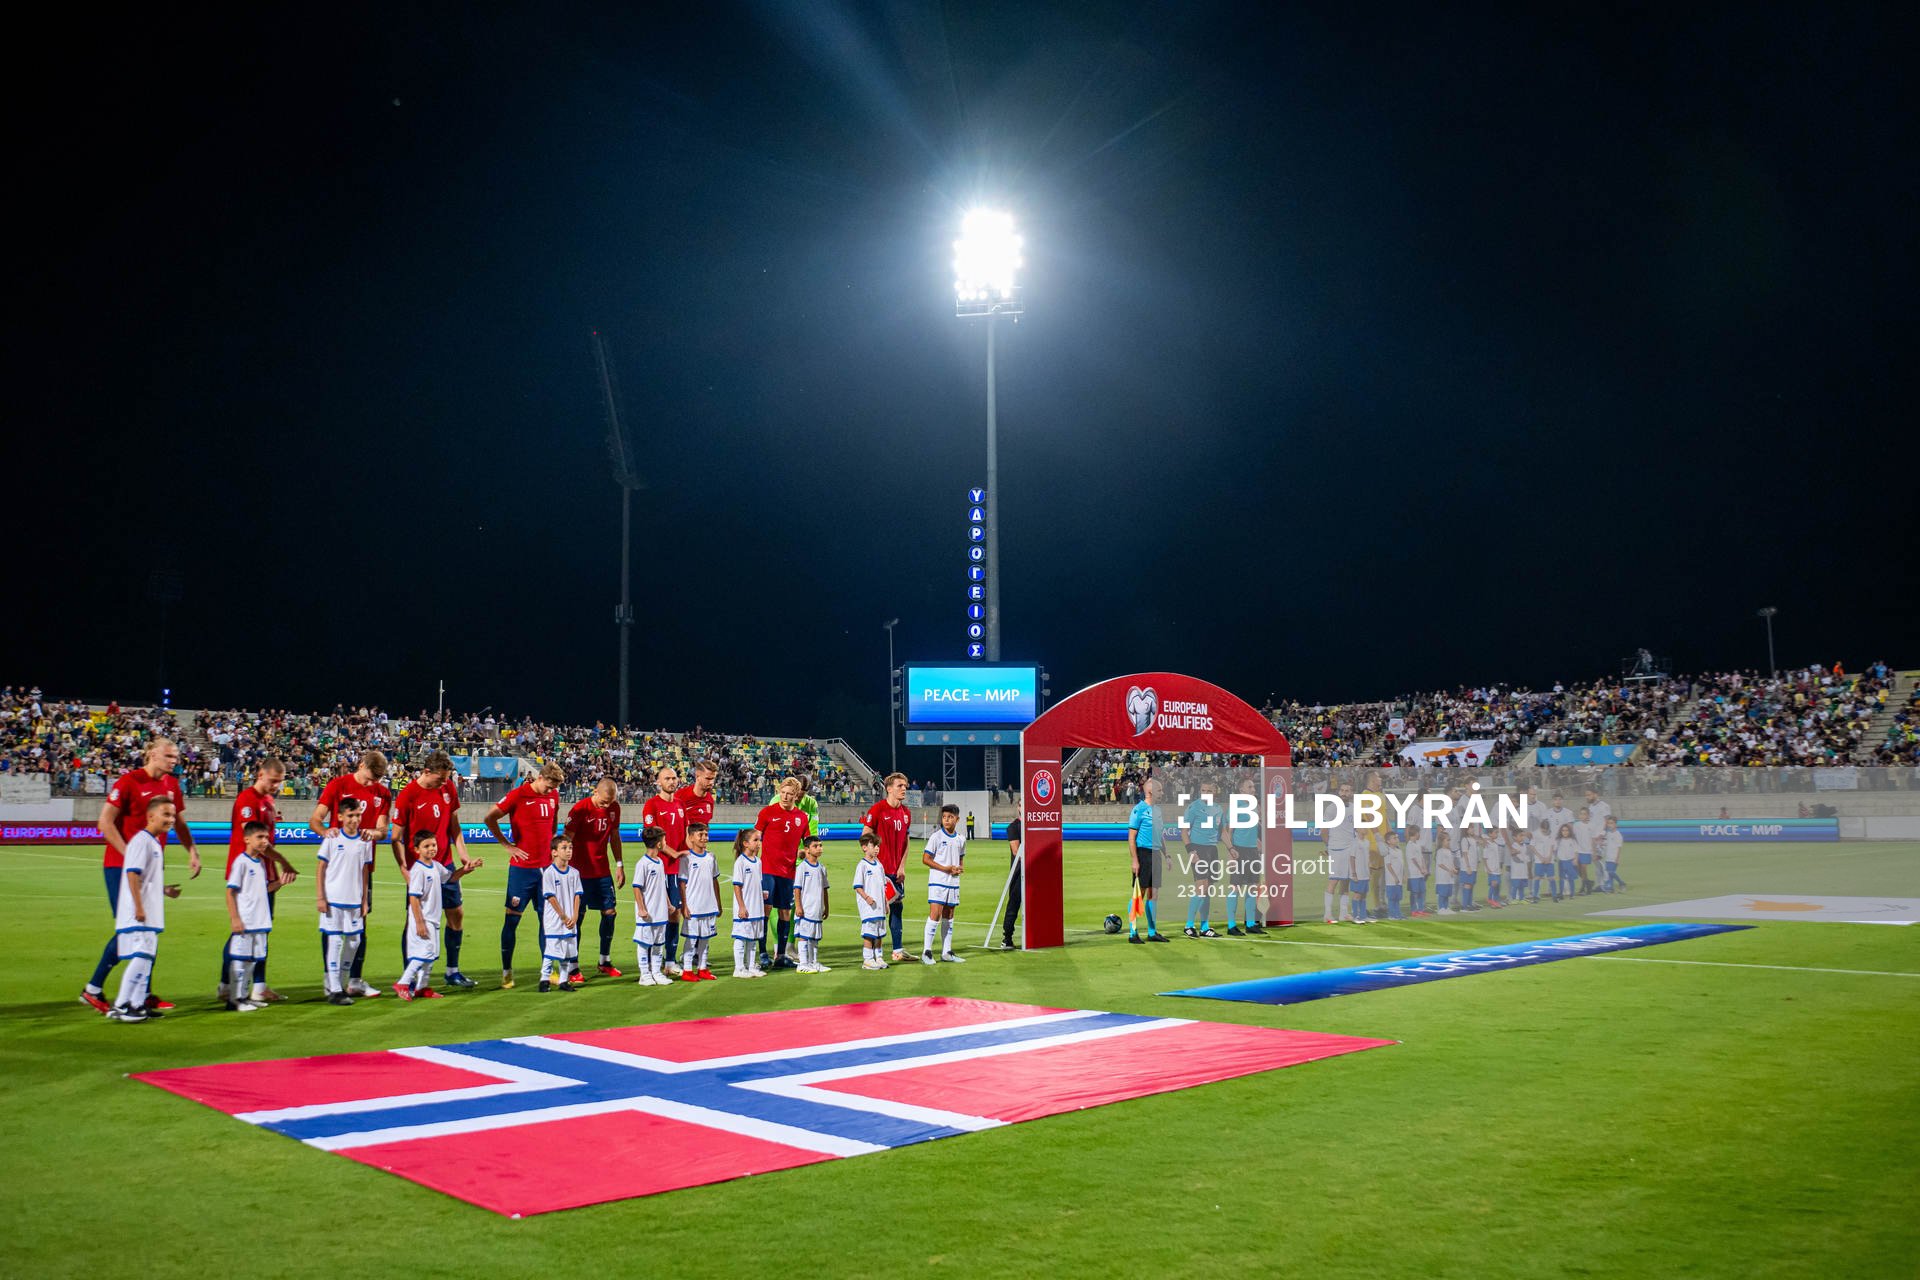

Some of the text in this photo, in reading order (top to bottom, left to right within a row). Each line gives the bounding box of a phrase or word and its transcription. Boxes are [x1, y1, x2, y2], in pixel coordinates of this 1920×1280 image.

[924, 689, 970, 701] PEACE
[1163, 700, 1208, 715] EUROPEAN
[1158, 714, 1213, 731] QUALIFIERS
[432, 804, 441, 818] 8
[540, 803, 549, 817] 11
[670, 812, 676, 825] 7
[1027, 811, 1060, 822] RESPECT
[598, 818, 607, 831] 15
[784, 821, 791, 833] 5
[893, 820, 902, 831] 10
[1700, 825, 1740, 836] PEACE
[4, 827, 67, 838] EUROPEAN
[469, 829, 495, 838] PEAC
